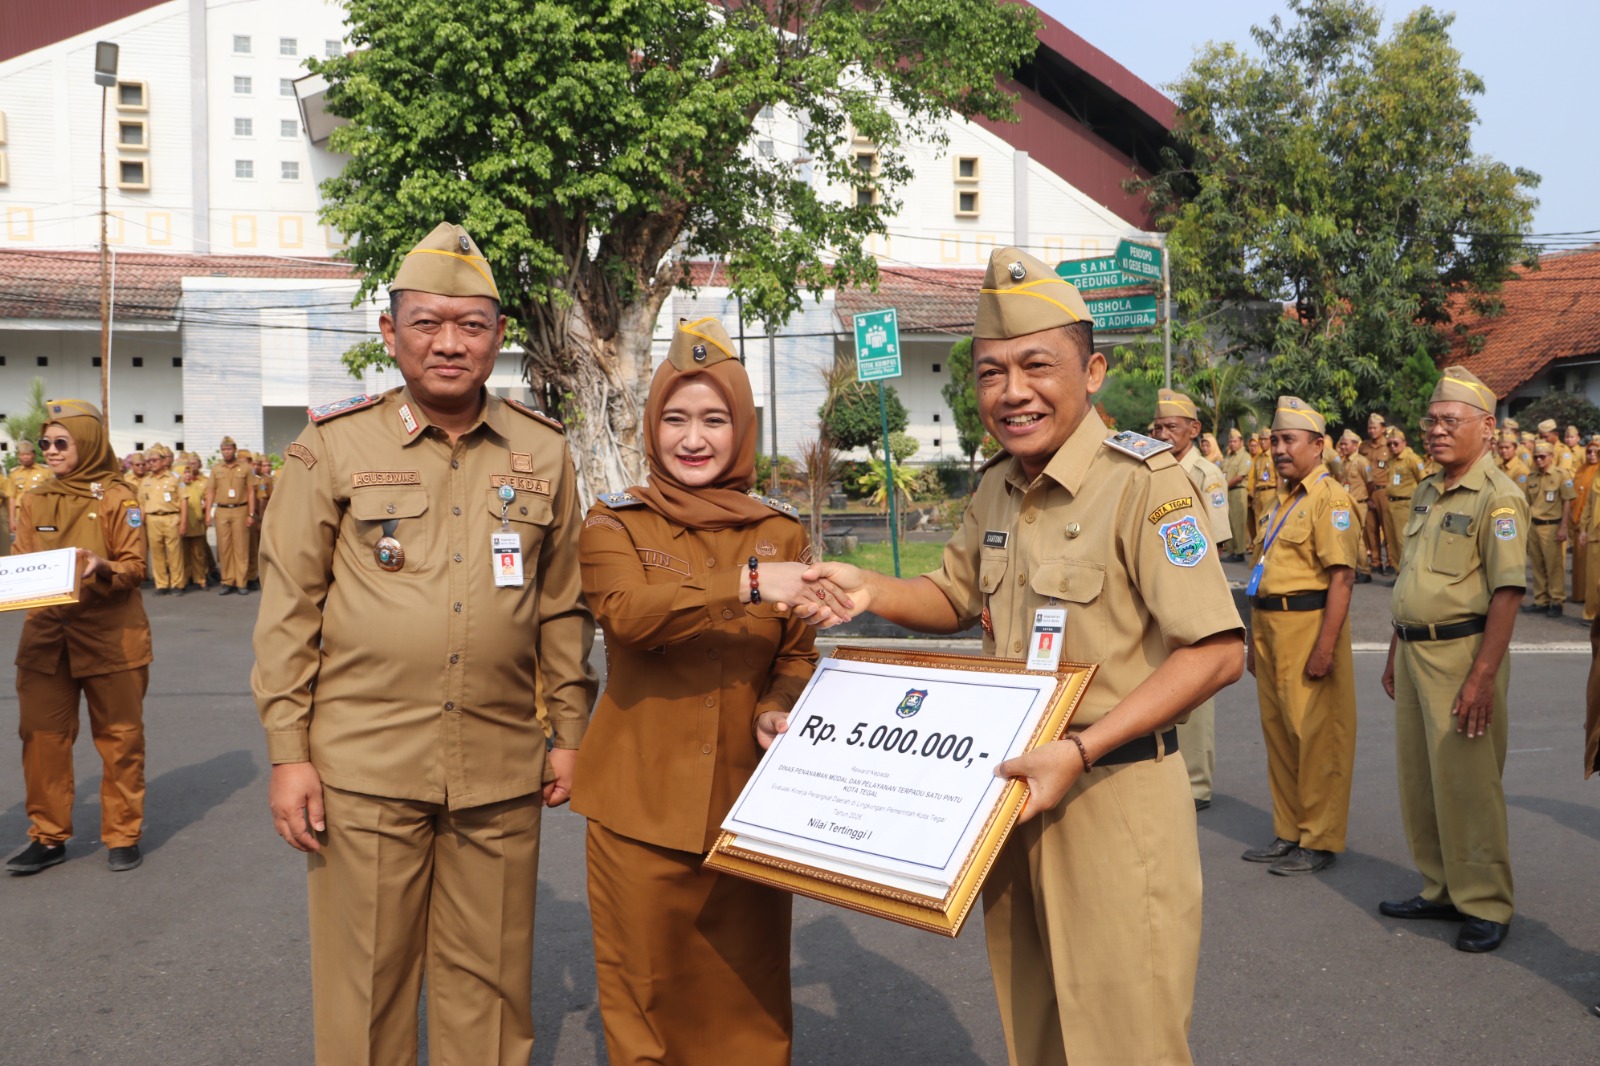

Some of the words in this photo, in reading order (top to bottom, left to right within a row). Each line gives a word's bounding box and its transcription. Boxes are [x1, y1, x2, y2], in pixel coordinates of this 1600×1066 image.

[1130, 246, 1152, 261] PENDOPO
[1080, 260, 1116, 273] SANT
[1129, 259, 1142, 273] GEDE
[1074, 274, 1118, 289] GEDUNG
[1108, 313, 1150, 327] ADIPURA
[357, 474, 384, 485] AGUS
[499, 477, 543, 492] SEKDA
[1151, 506, 1168, 521] KOTA
[1169, 499, 1190, 509] TEGAL
[645, 551, 670, 566] IIN
[799, 715, 837, 745] Rp.
[846, 722, 989, 768] 5.000.000,-
[778, 764, 795, 773] DINAS
[795, 767, 828, 779] PENANAMAN
[828, 774, 848, 784] MODAL
[848, 778, 861, 786] DAN
[861, 780, 897, 792] PELAYANAN
[897, 786, 926, 797] TERPADU
[925, 791, 943, 800] SATU
[943, 794, 963, 804] PINTU
[843, 785, 859, 794] KOTA
[859, 788, 878, 797] TEGAL
[807, 817, 829, 830] Nilai
[828, 821, 868, 841] Tertinggi
